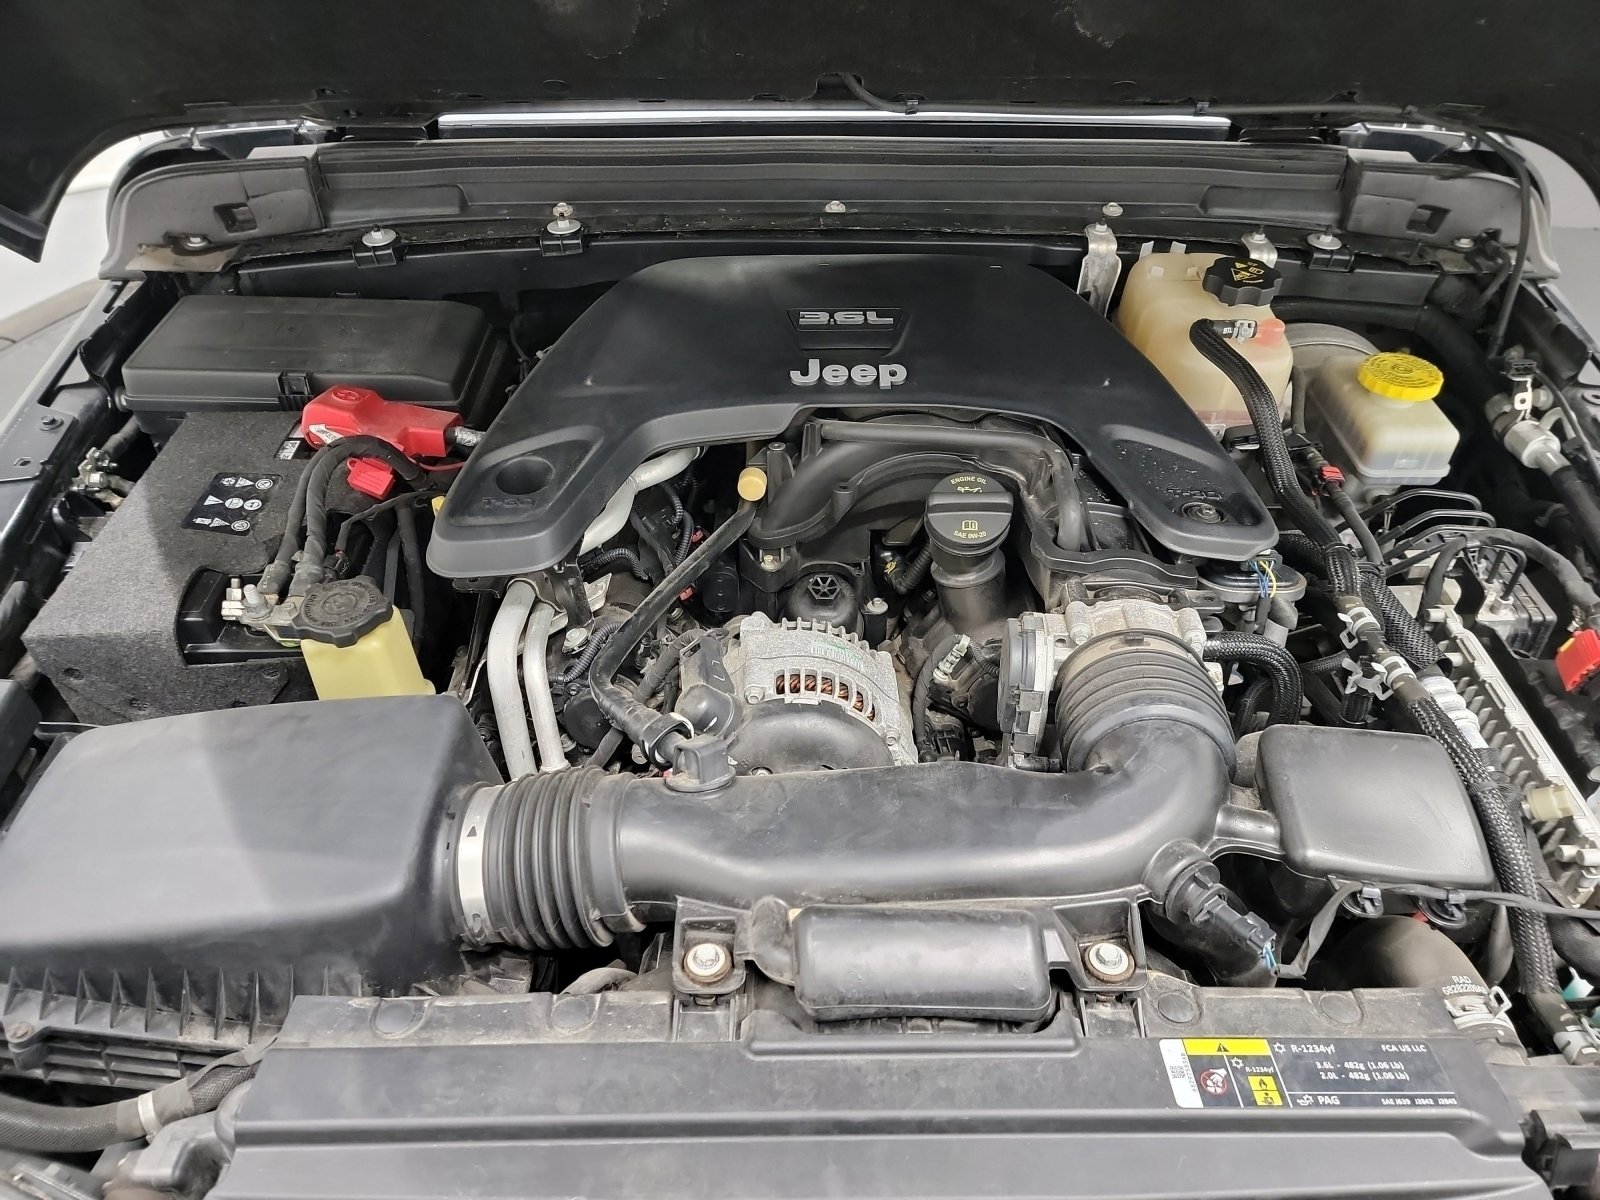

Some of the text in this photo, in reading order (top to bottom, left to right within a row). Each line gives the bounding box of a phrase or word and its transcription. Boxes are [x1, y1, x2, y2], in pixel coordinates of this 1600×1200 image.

[798, 311, 894, 325] 3.6L
[789, 358, 908, 390] Jeep
[950, 476, 987, 485] ENGINE OIL
[953, 530, 987, 539] SAE 0W-20
[1451, 975, 1472, 984] RAD
[1290, 1043, 1427, 1054] R-1234yf FCA US LLC
[1245, 1066, 1275, 1074] R-1234yf
[1315, 1061, 1335, 1069] 3.6L
[1344, 1061, 1366, 1070] 482g
[1367, 1061, 1388, 1070] (1.06
[1320, 1072, 1340, 1080] 2.0L
[1348, 1072, 1371, 1081] 482g
[1372, 1072, 1393, 1081] (1.06
[1316, 1095, 1341, 1105] PAG
